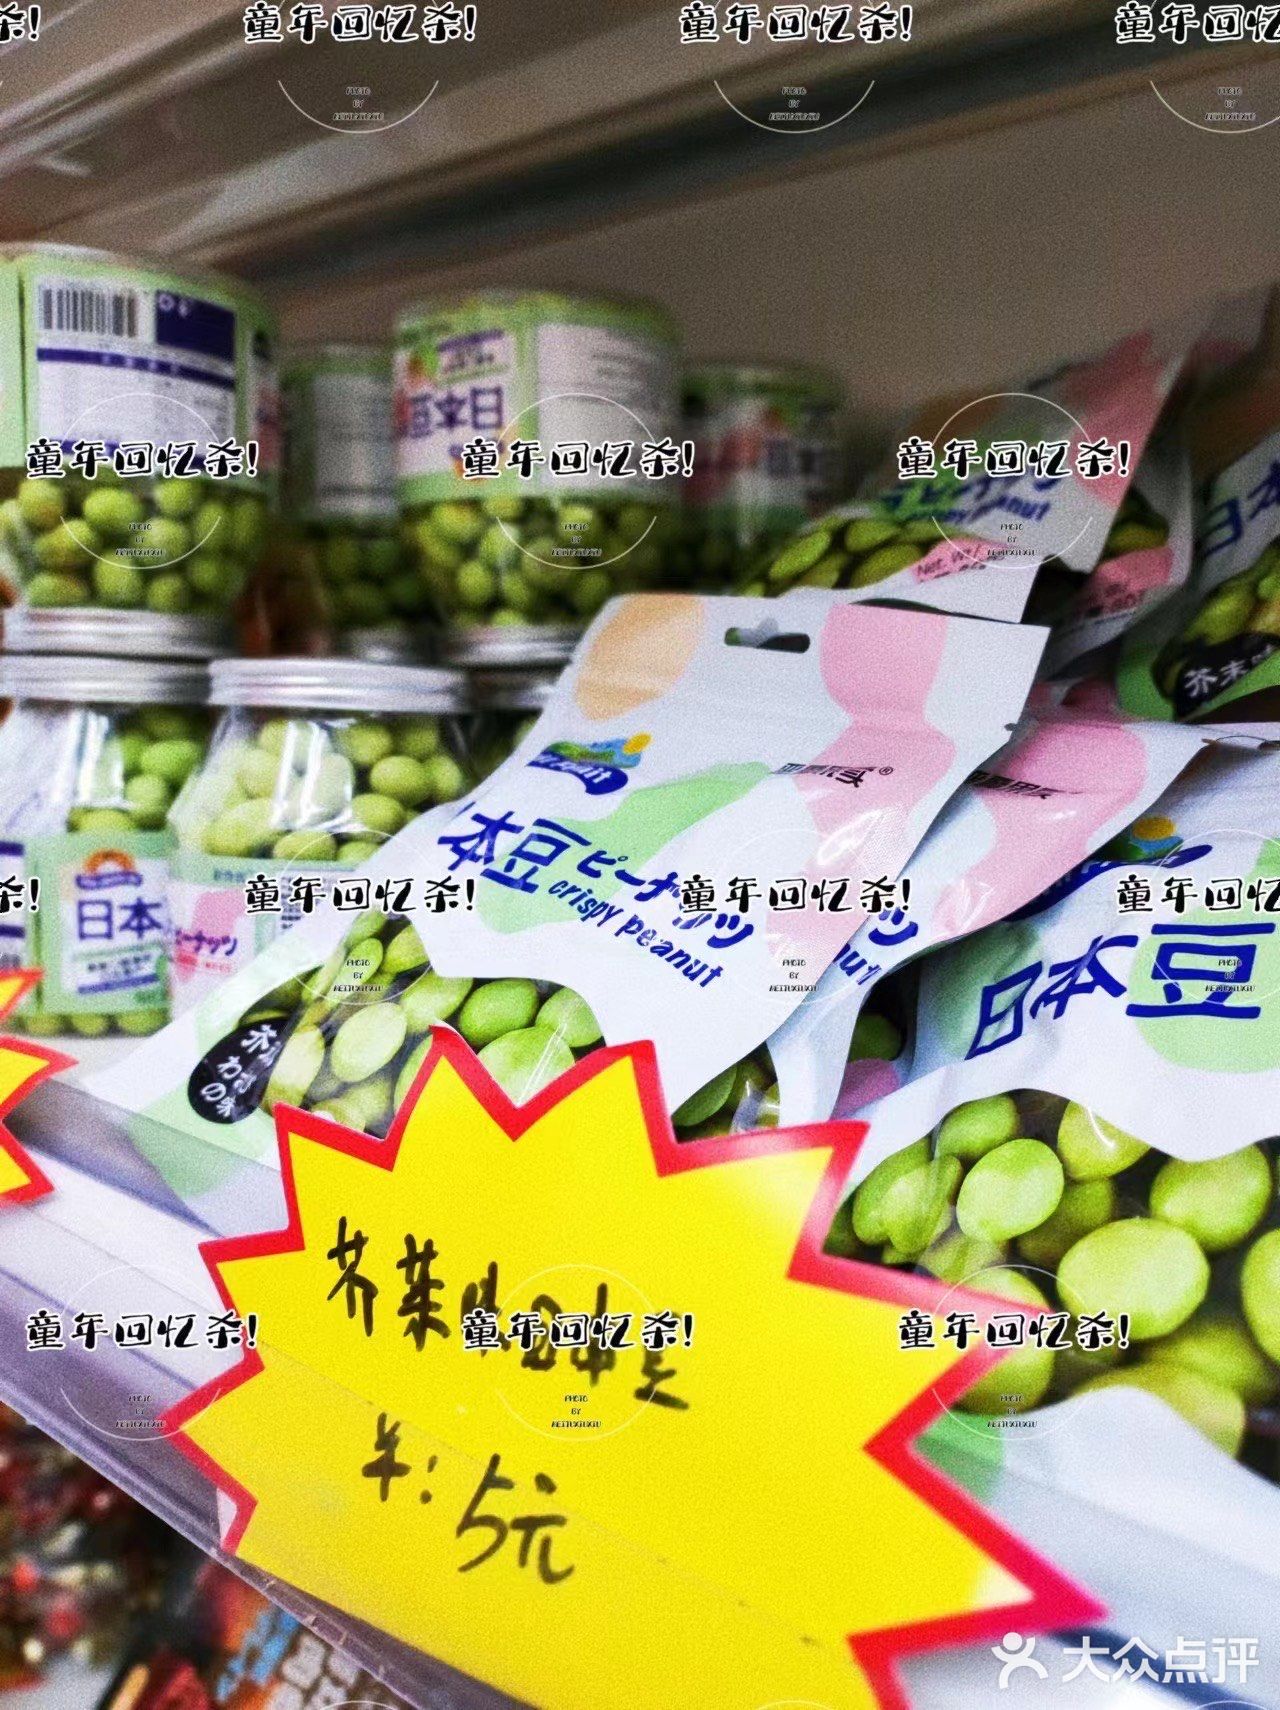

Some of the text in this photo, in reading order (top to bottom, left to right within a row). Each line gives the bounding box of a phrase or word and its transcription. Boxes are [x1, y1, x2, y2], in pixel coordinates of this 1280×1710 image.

[547, 878, 724, 989] crispy peanut
[964, 922, 1277, 1061] 日本豆
